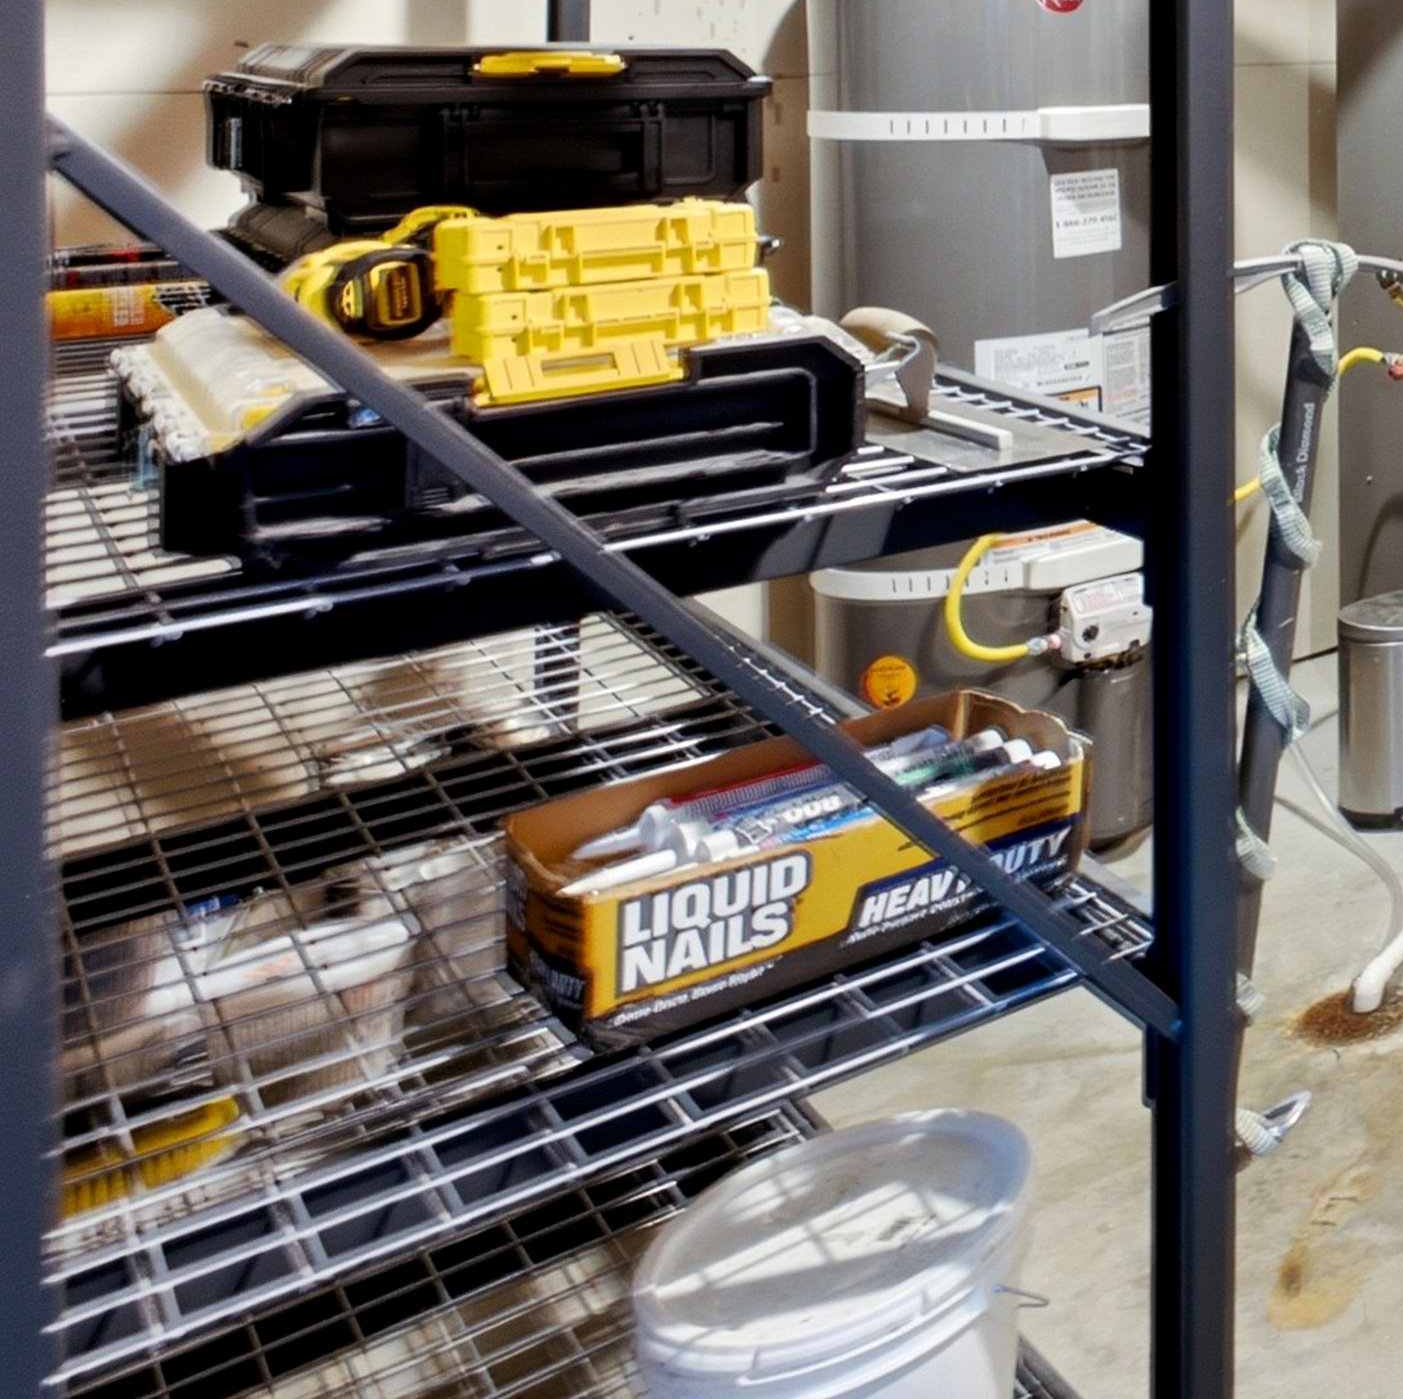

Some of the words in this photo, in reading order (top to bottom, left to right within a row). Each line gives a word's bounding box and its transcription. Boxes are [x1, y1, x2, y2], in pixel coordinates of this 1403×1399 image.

[1296, 402, 1316, 464] Diamond
[621, 900, 789, 993] NAILS
[623, 854, 808, 947] LIQUID
